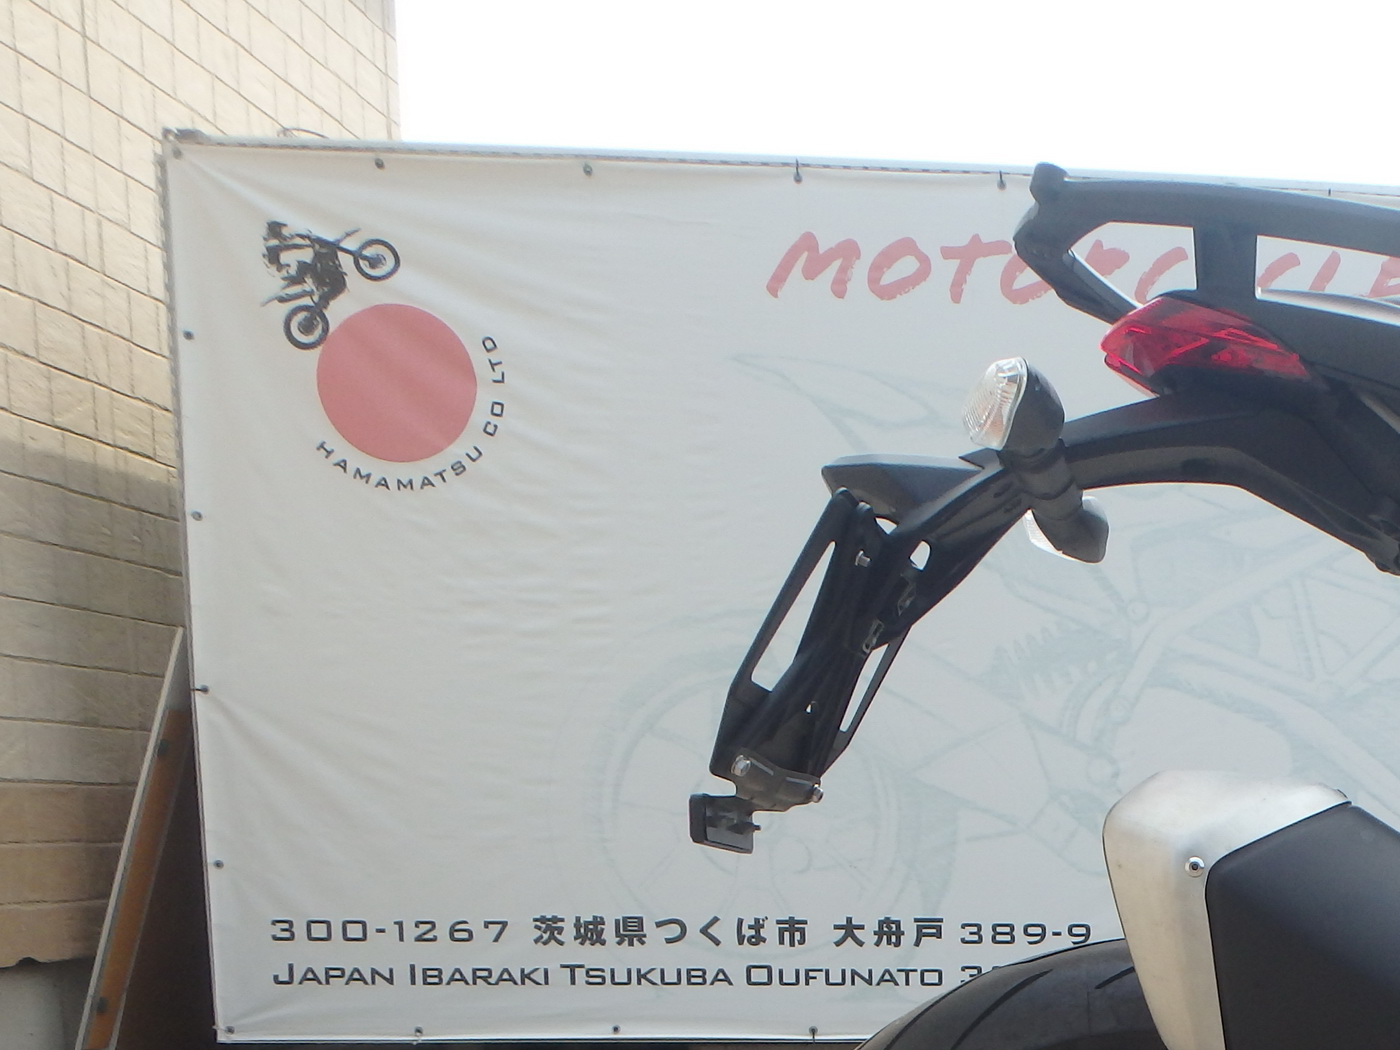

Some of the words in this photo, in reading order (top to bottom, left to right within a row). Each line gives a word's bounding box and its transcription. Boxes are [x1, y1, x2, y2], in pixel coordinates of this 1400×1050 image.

[482, 336, 505, 384] LTD
[483, 401, 504, 437] CO
[316, 441, 483, 491] HAMAMATSU
[271, 919, 509, 943] 300-1267
[533, 915, 808, 947] 茨城県つくば市
[833, 916, 944, 947] 大舟戸
[960, 922, 1092, 945] 389-9
[273, 963, 394, 985] JAPAN
[410, 963, 549, 985] IBARAKI
[560, 963, 734, 985] TSUKUBA
[745, 964, 943, 986] OUFUNATO
